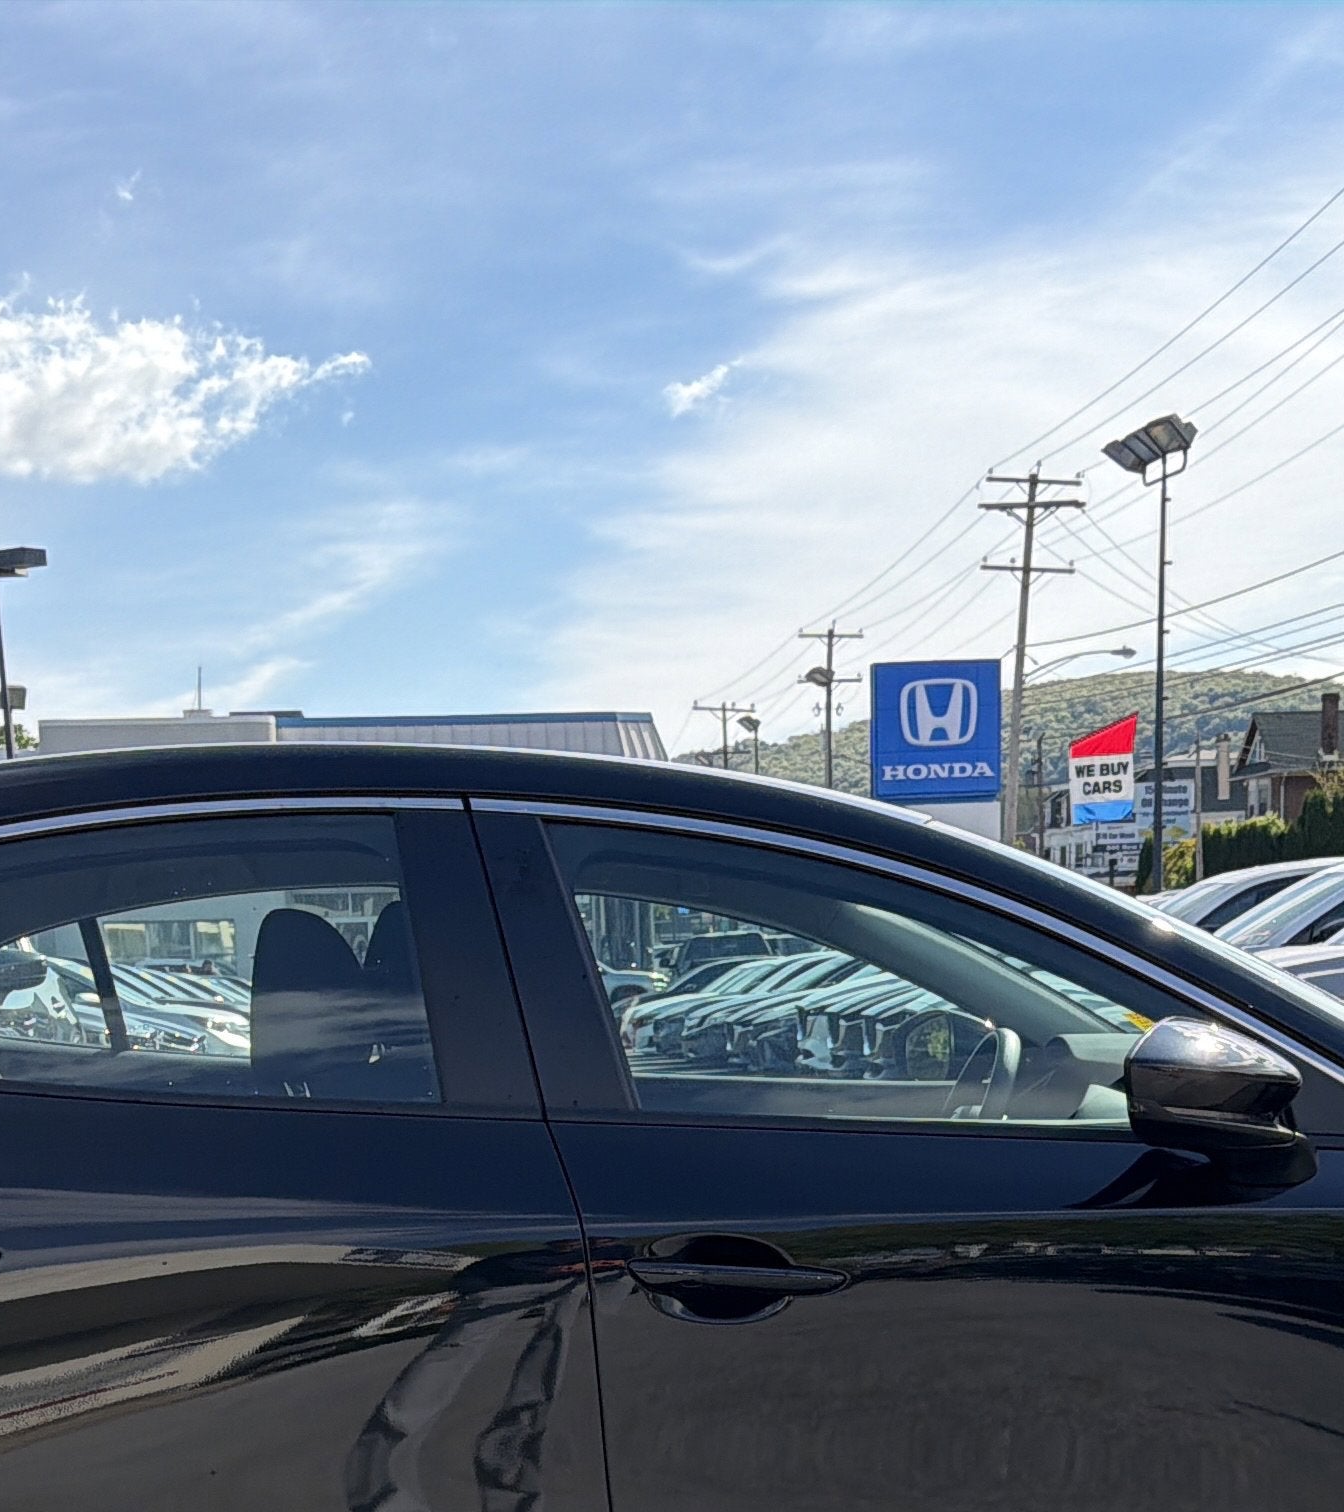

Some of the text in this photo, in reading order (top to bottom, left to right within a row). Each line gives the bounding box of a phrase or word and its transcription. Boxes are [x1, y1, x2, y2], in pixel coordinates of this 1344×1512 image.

[881, 762, 995, 781] HONDA
[1074, 761, 1130, 779] WE BUY
[1082, 779, 1123, 796] CARS
